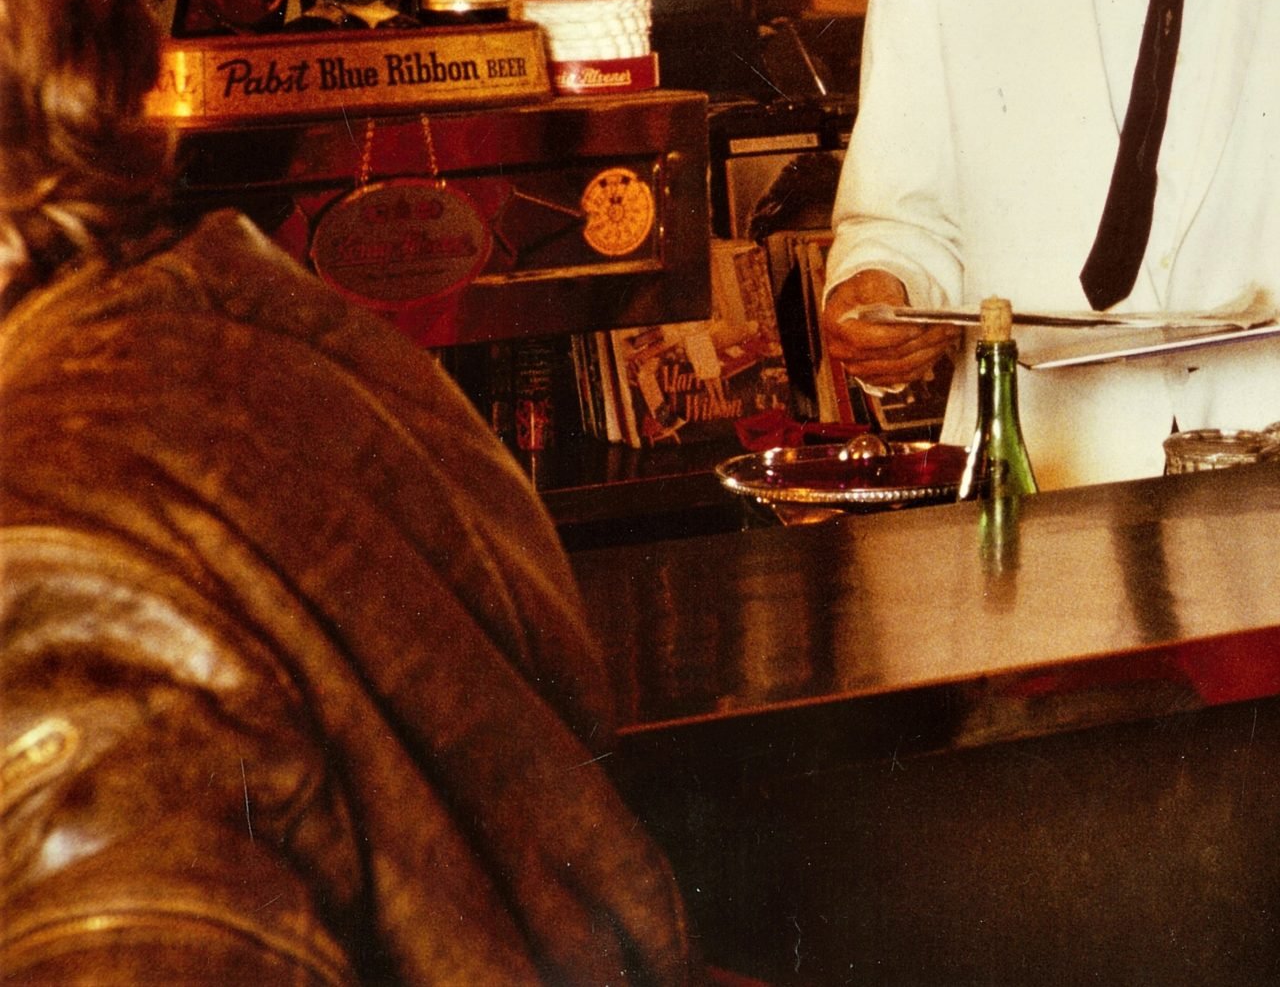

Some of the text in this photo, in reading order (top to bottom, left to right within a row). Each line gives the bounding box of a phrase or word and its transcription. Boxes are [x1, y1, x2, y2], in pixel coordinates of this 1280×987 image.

[217, 59, 311, 98] Pabst
[317, 57, 379, 91] Blue
[385, 51, 480, 86] Ribbon
[486, 56, 527, 78] BEER
